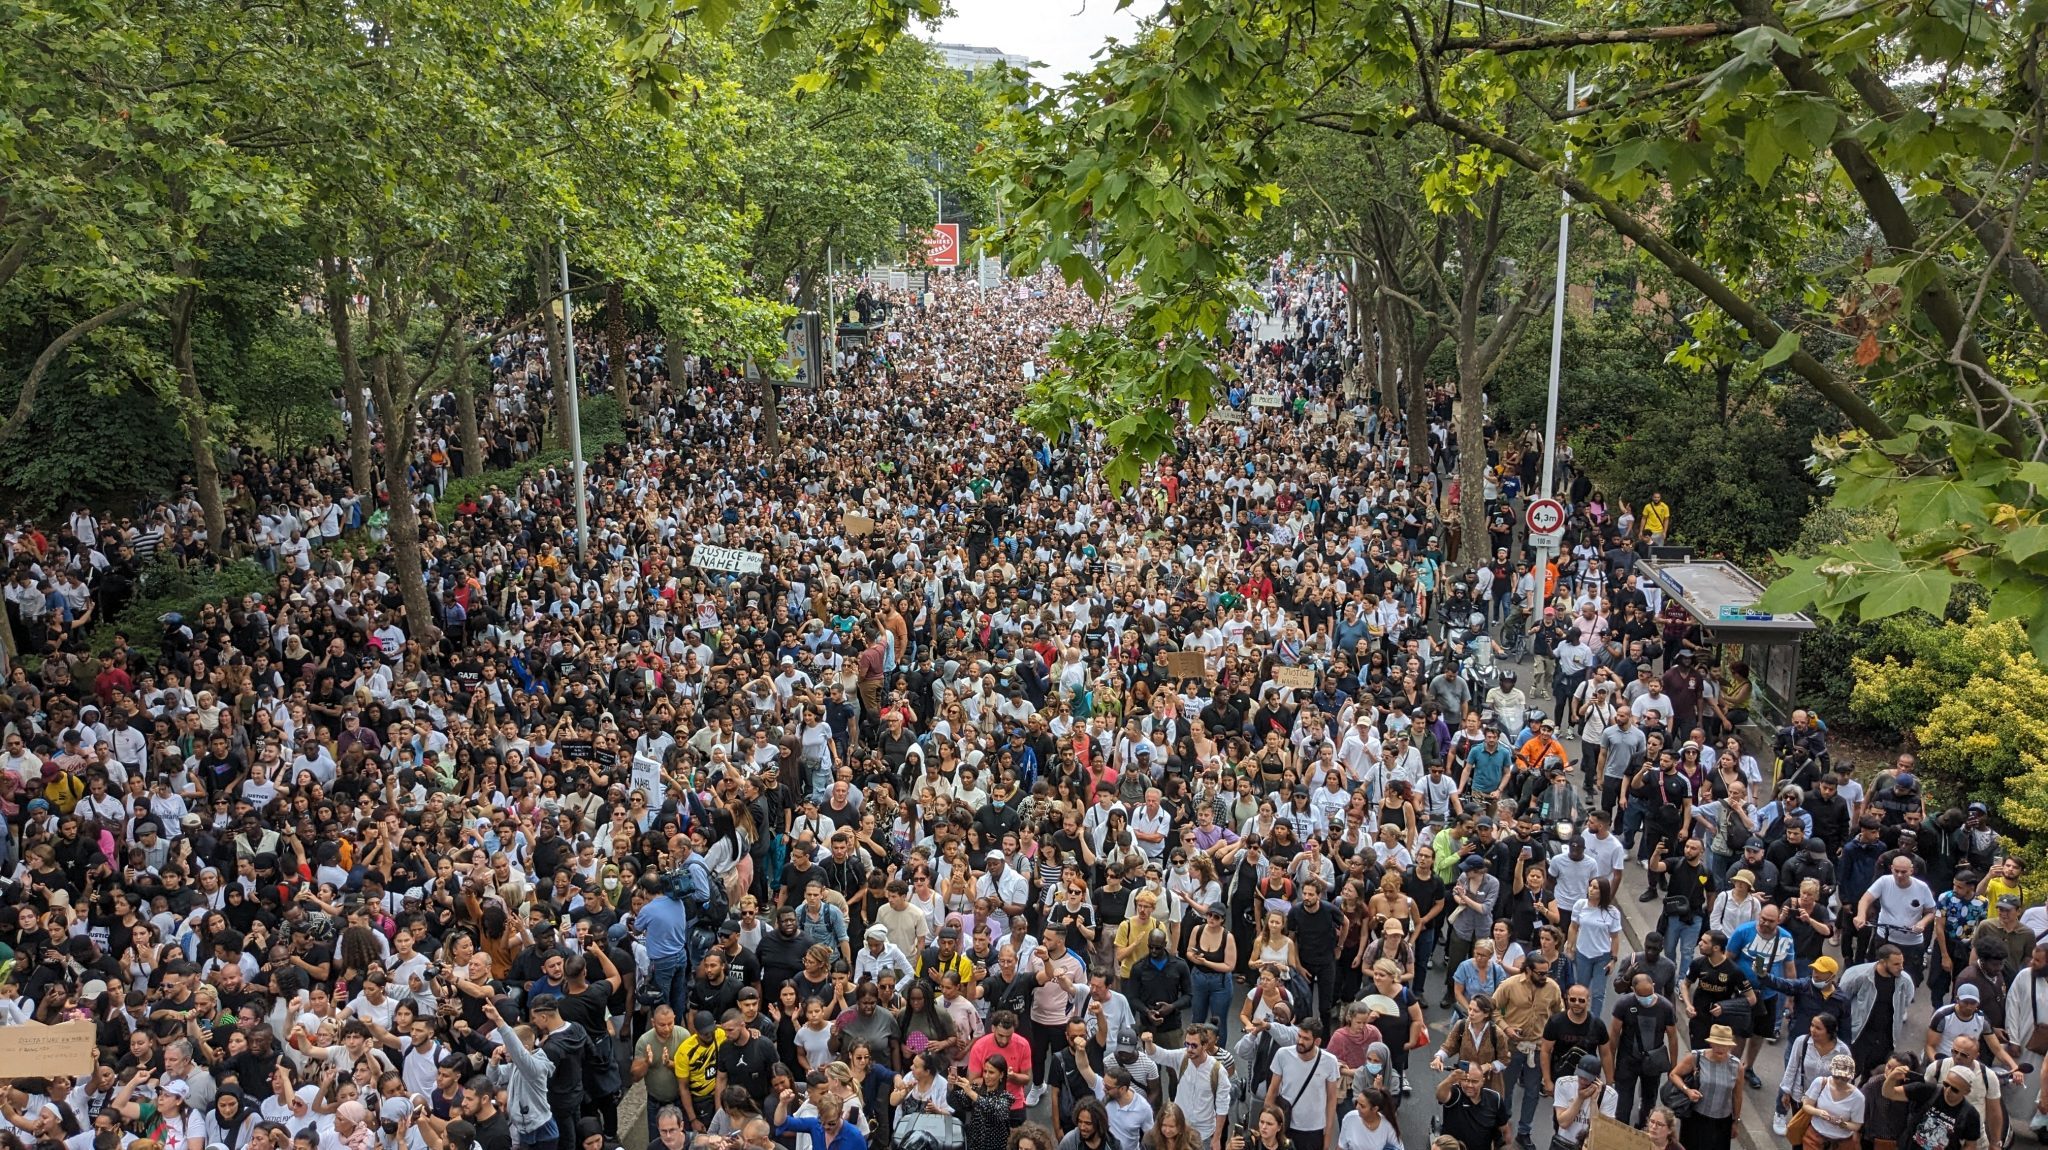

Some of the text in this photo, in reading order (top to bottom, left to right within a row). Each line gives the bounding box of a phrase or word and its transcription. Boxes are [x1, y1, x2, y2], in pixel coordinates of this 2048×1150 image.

[1534, 512, 1557, 523] 4,3m
[699, 547, 743, 560] JUSTICE
[700, 555, 740, 571] NAHEL
[1283, 667, 1308, 677] JUSTICE
